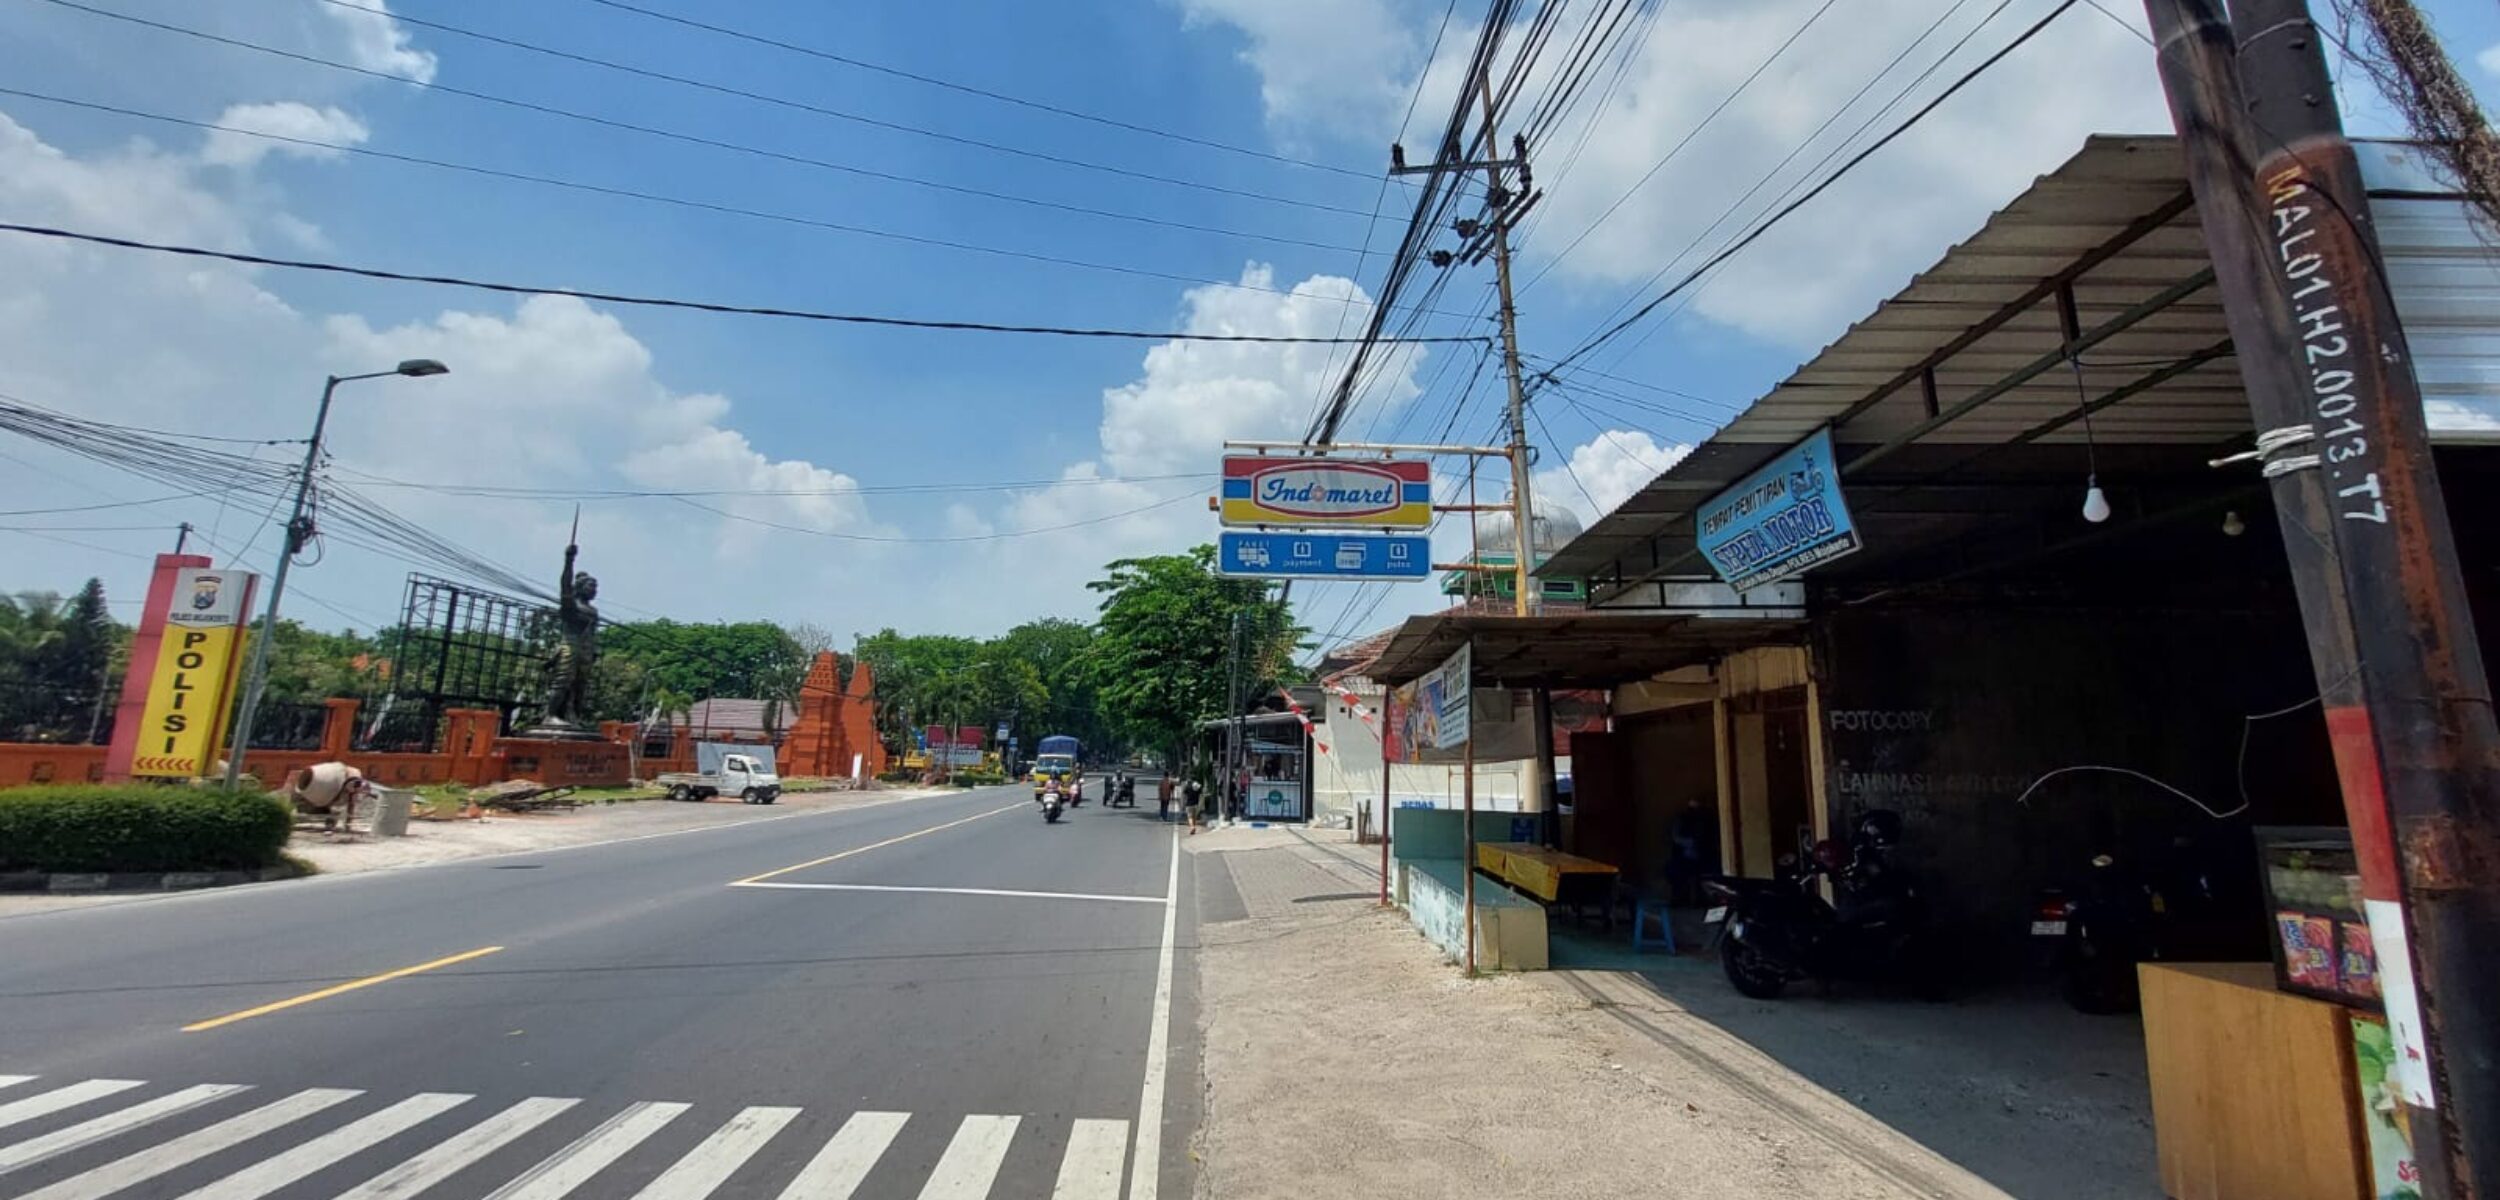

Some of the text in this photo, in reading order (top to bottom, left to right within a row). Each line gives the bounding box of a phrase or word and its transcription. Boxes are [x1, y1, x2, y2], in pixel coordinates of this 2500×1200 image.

[2268, 168, 2388, 525] MAL01.H2.0013.T7
[1262, 478, 1394, 504] Indomaret
[1703, 505, 1733, 536] TEMPAT
[1713, 497, 1834, 576] SEPEDA MOTOR
[163, 632, 207, 754] POLISI
[1828, 709, 1936, 732] FOTOCOPY
